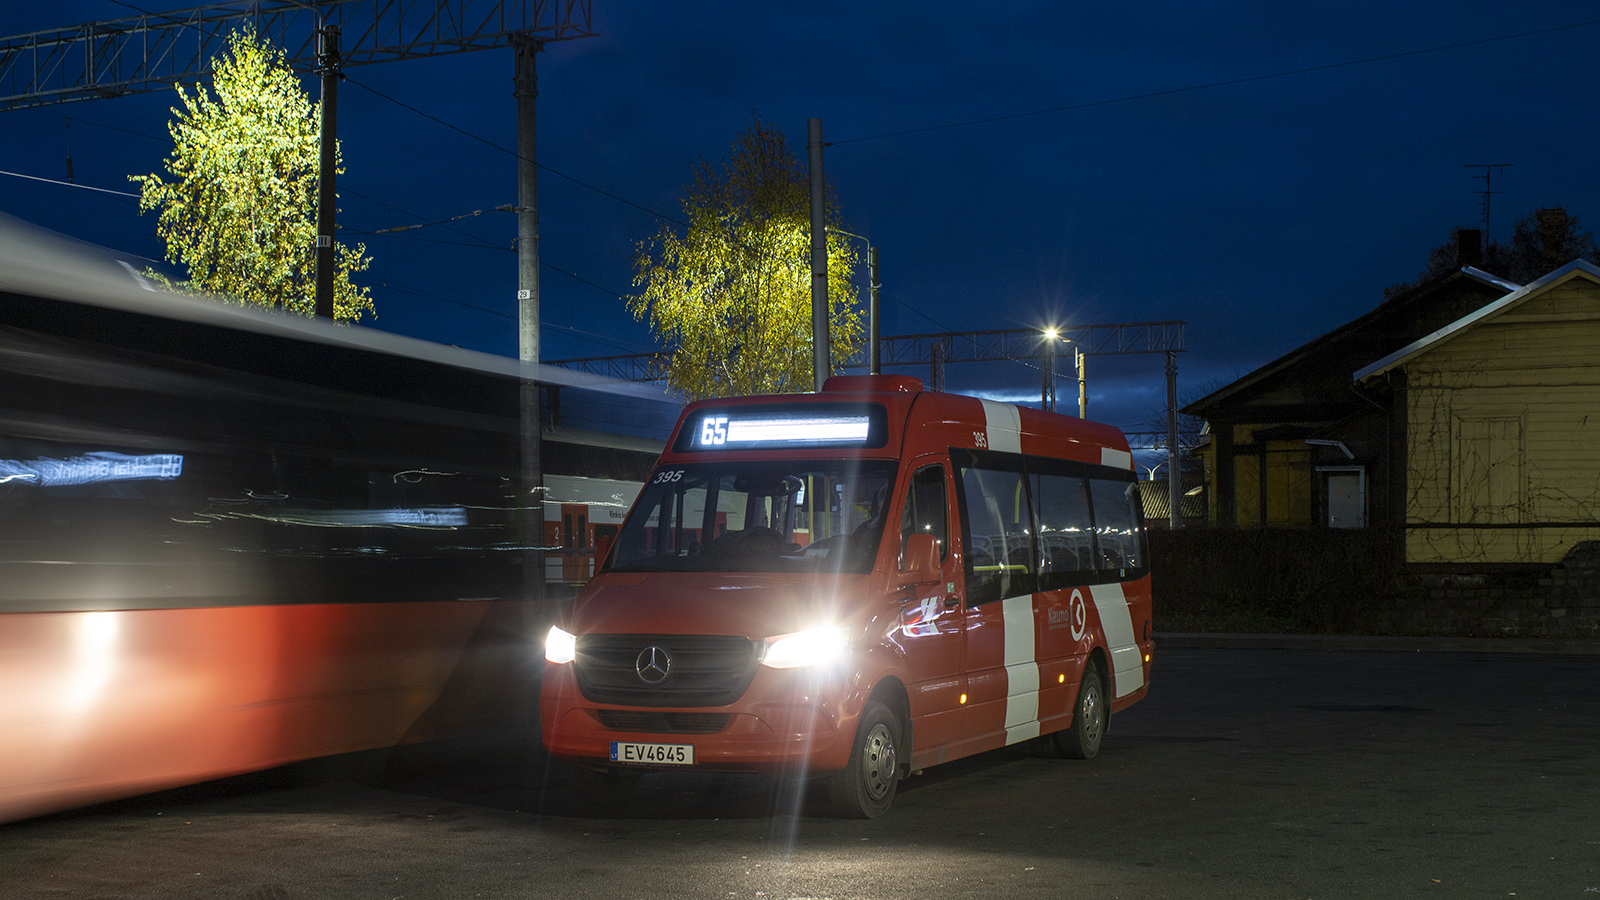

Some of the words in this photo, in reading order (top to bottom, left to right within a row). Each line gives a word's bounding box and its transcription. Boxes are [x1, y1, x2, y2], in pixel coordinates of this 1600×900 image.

[701, 417, 728, 445] 65
[972, 431, 987, 448] 395
[653, 470, 685, 484] 395
[554, 526, 560, 540] 2
[1047, 607, 1069, 625] Kauno
[624, 745, 685, 762] EV4645
